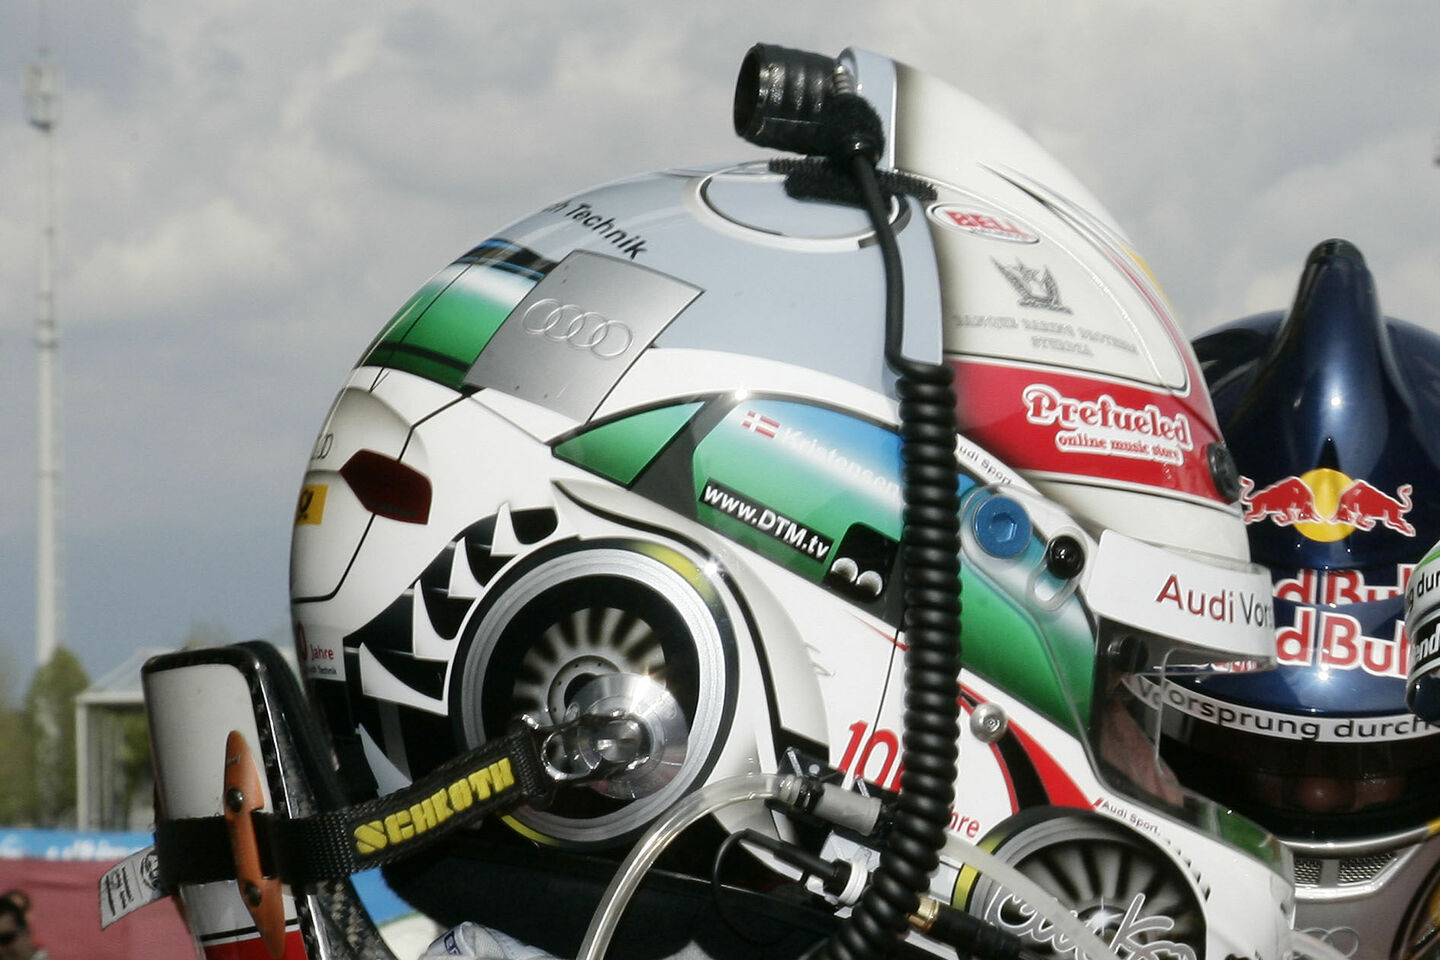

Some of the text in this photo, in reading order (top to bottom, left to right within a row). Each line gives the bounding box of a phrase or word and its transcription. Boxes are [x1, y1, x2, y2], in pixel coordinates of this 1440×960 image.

[565, 203, 647, 259] Technik
[1024, 391, 1189, 445] Prefueled
[1058, 432, 1106, 449] online
[1110, 438, 1149, 454] music
[959, 446, 979, 462] udi
[703, 485, 829, 559] www.DTM.tv
[1155, 573, 1234, 624] Audi
[1320, 612, 1411, 678] Bul
[353, 756, 517, 855] SCHROTH
[1101, 800, 1128, 820] Audi
